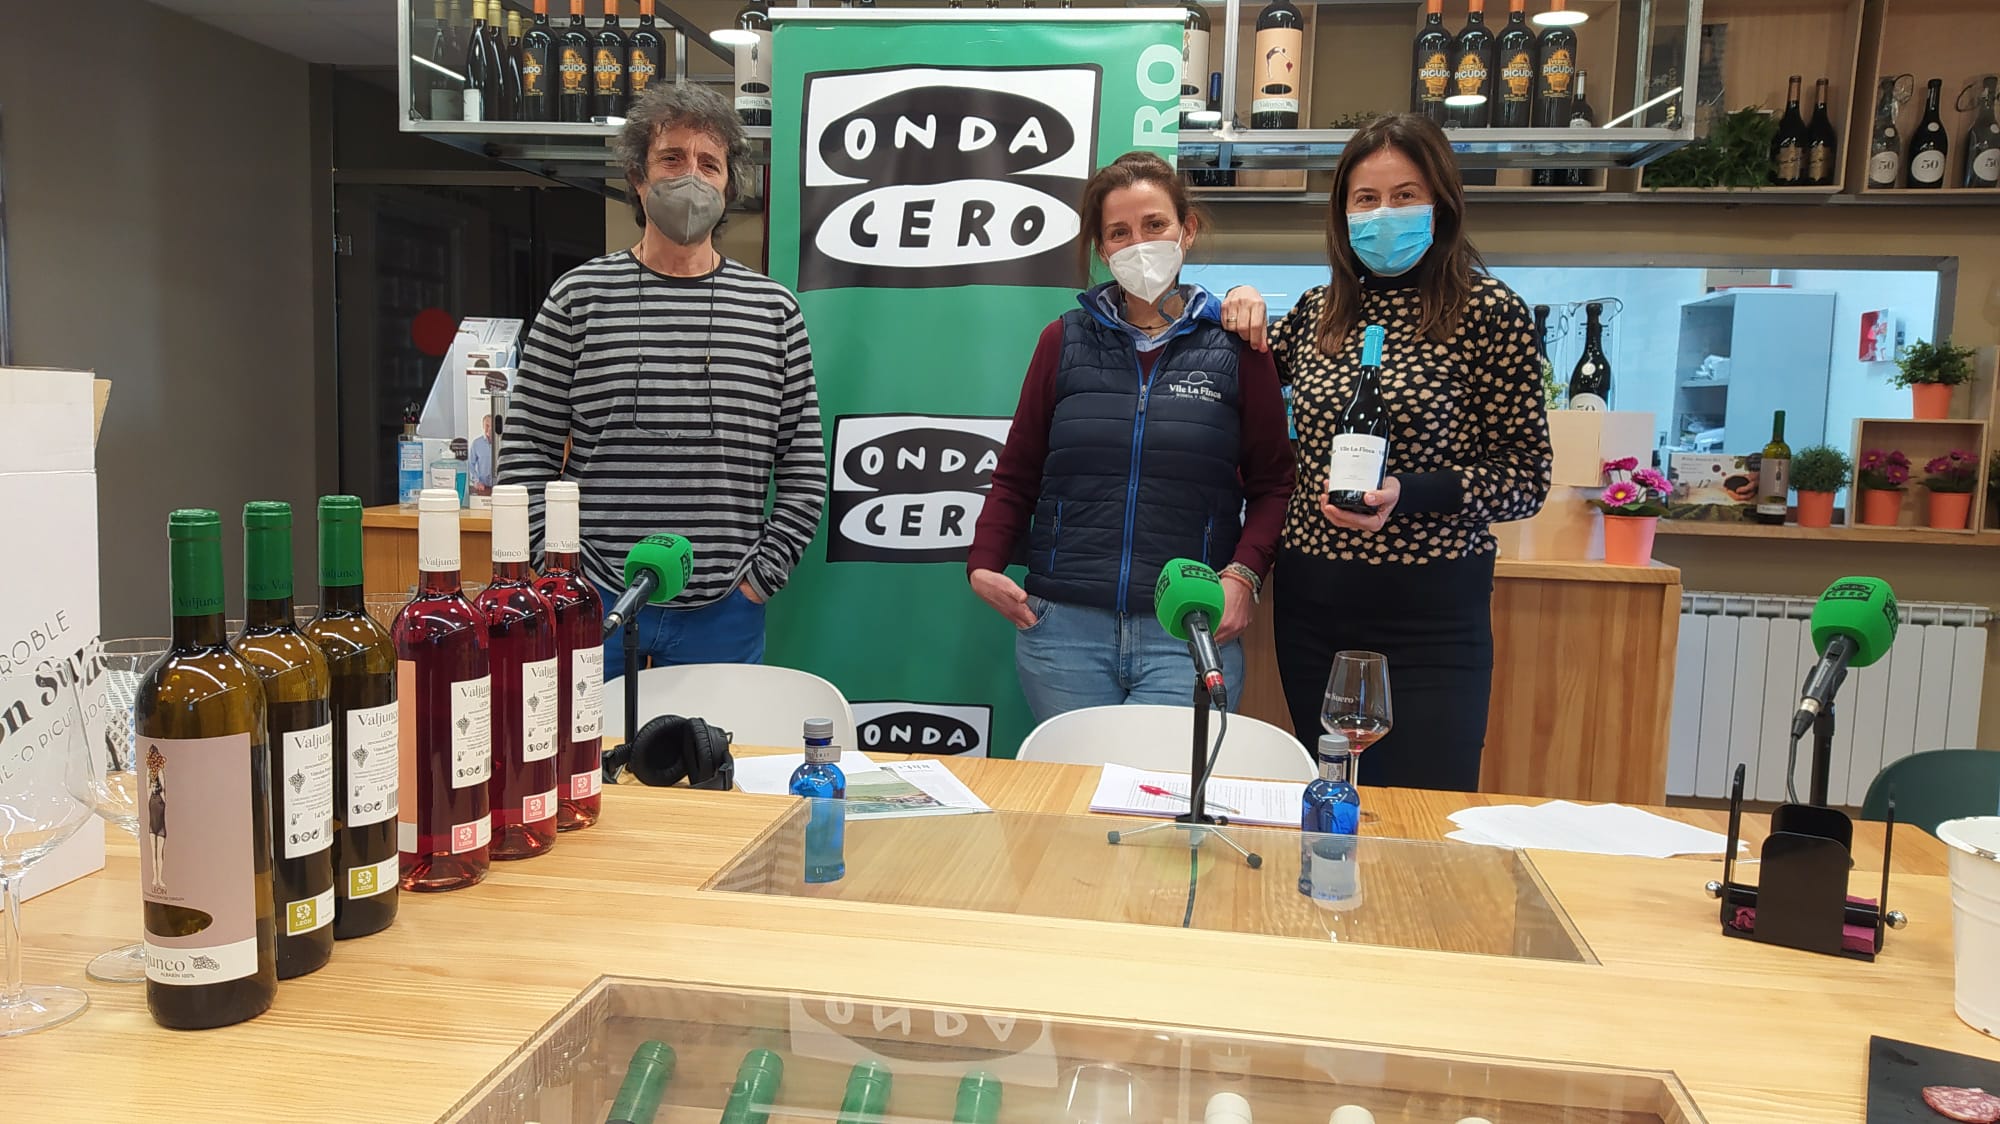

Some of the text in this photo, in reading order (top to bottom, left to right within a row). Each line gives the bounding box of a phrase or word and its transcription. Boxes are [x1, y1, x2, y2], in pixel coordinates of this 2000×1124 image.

[1132, 44, 1182, 170] RO
[844, 114, 1048, 160] ONDA
[849, 199, 1046, 248] CERO
[1187, 385, 1199, 394] La
[1200, 386, 1222, 399] Finca
[860, 446, 999, 476] ONDA
[865, 503, 965, 536] CER
[0, 609, 71, 676] ROBLE
[863, 723, 967, 747] ONDA
